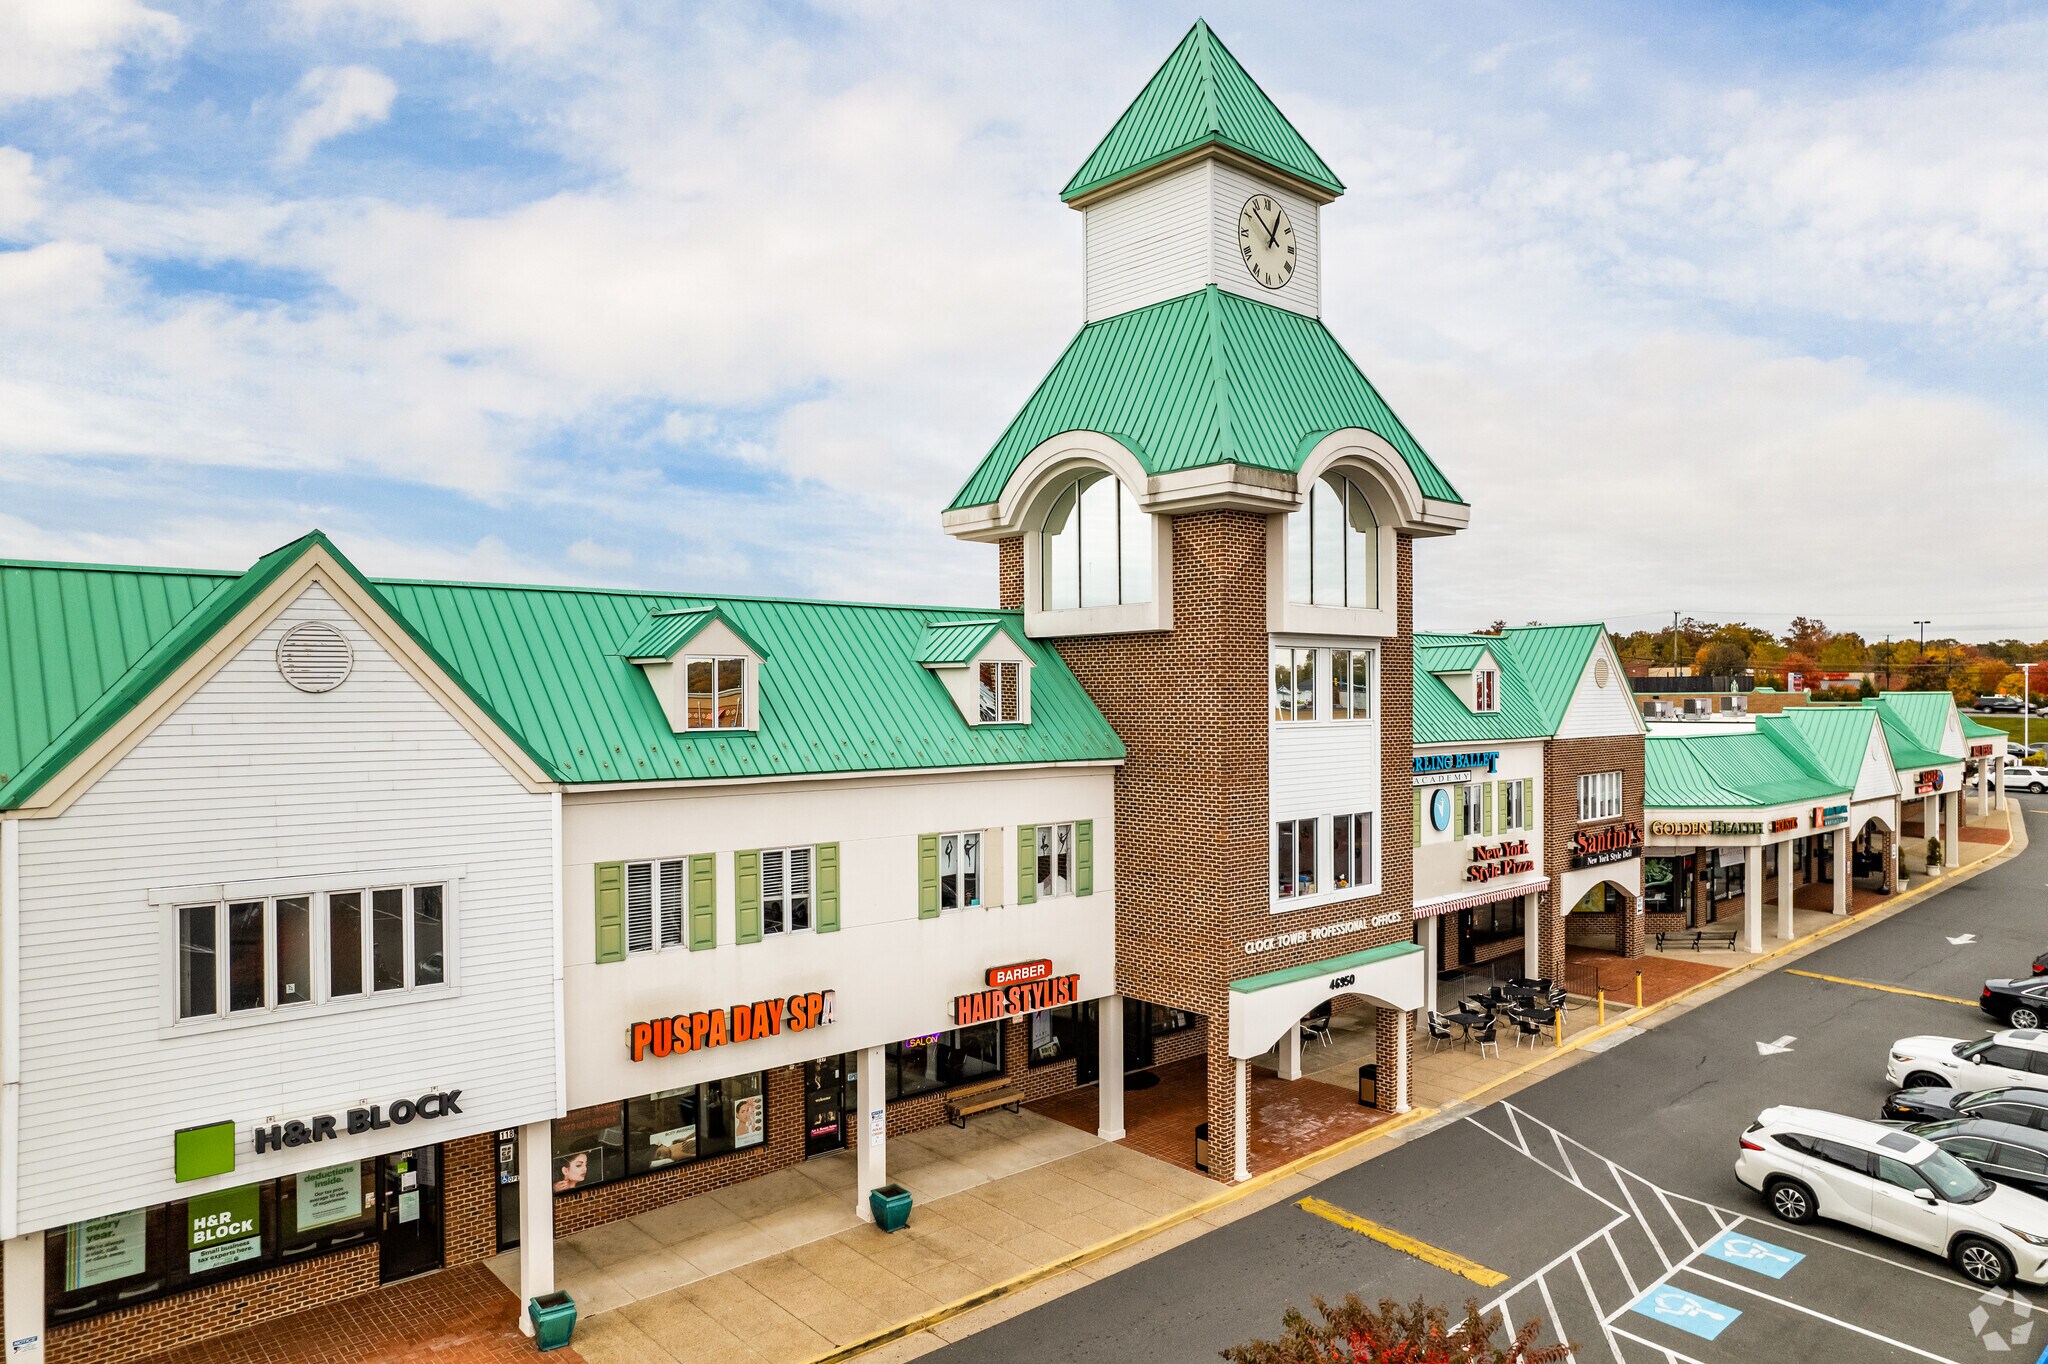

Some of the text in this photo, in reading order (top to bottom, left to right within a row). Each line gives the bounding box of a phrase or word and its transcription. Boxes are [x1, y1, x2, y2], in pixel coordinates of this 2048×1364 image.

[1412, 751, 1499, 774] RLING BALLET
[1414, 772, 1470, 784] ACADEMY
[1651, 819, 1764, 835] GOLDEN HEALTH
[1574, 822, 1643, 856] Santini's
[1473, 840, 1529, 863] New York
[1588, 849, 1633, 865] New York Style Deli
[1467, 859, 1534, 883] Style Pizza
[1244, 911, 1401, 955] CLOCK TOWER PROFESSIONAL OFFICES
[997, 964, 1045, 983] BARBER
[954, 974, 1080, 1025] HAIR STYLIST
[631, 989, 837, 1062] PUSPA DAY SPA
[909, 1036, 938, 1048] SALON
[255, 1089, 463, 1154] H&R BLOCK
[501, 1130, 514, 1140] 118
[304, 1166, 354, 1183] deductions
[314, 1176, 344, 1188] inside.
[309, 1195, 329, 1204] average
[336, 1190, 349, 1198] years
[86, 1219, 121, 1233] every
[193, 1211, 232, 1231] H&R
[86, 1230, 116, 1243] year.
[193, 1219, 254, 1245] BLOCK
[197, 1255, 209, 1264] tax
[209, 1249, 236, 1262] experts
[236, 1245, 254, 1254] here.
[200, 1240, 251, 1257] Small business
